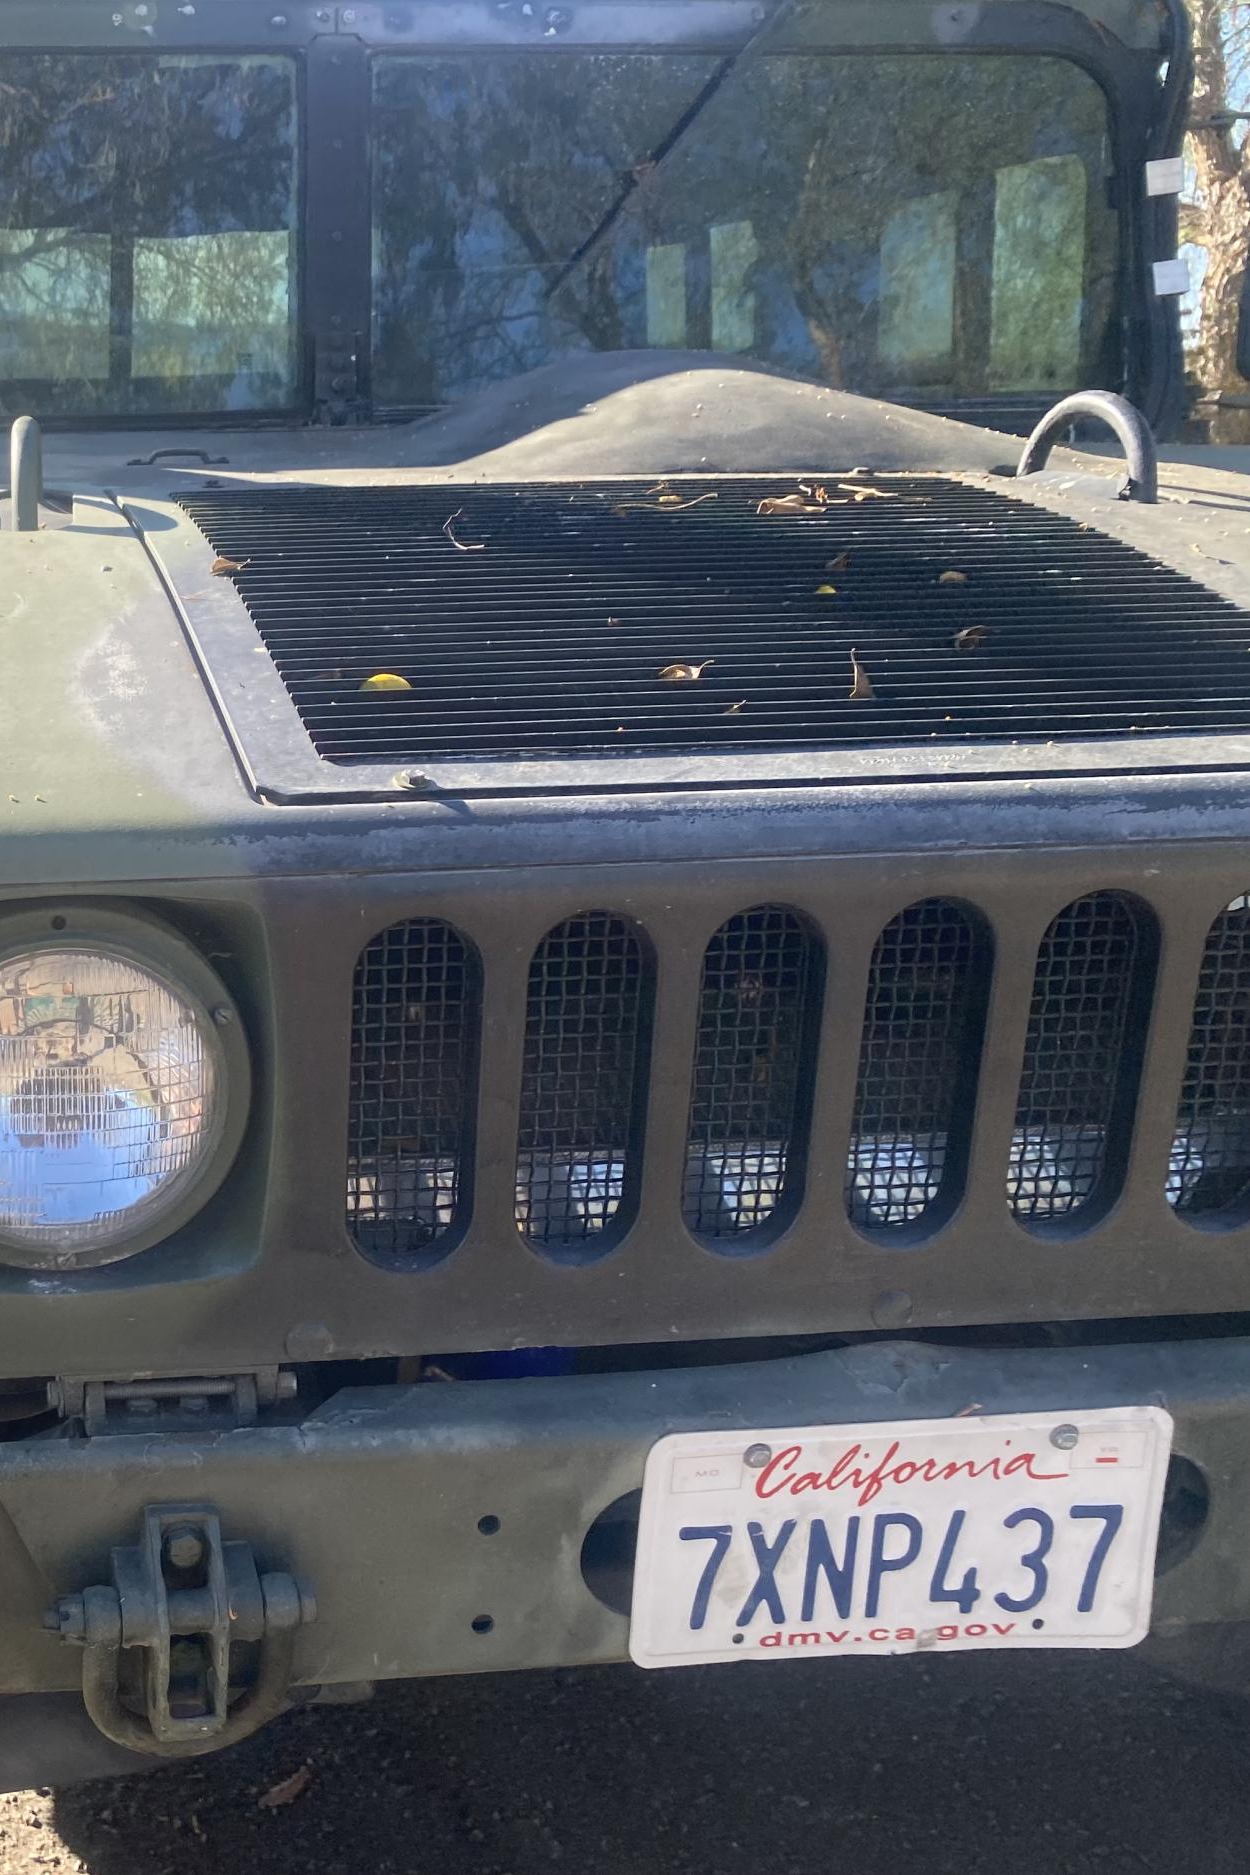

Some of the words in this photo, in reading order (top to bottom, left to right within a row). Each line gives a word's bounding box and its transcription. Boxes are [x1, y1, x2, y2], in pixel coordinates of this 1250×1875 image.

[756, 1441, 1067, 1507] California
[679, 1504, 1123, 1630] 7XNP437
[757, 1622, 1017, 1648] dmv.cagov
